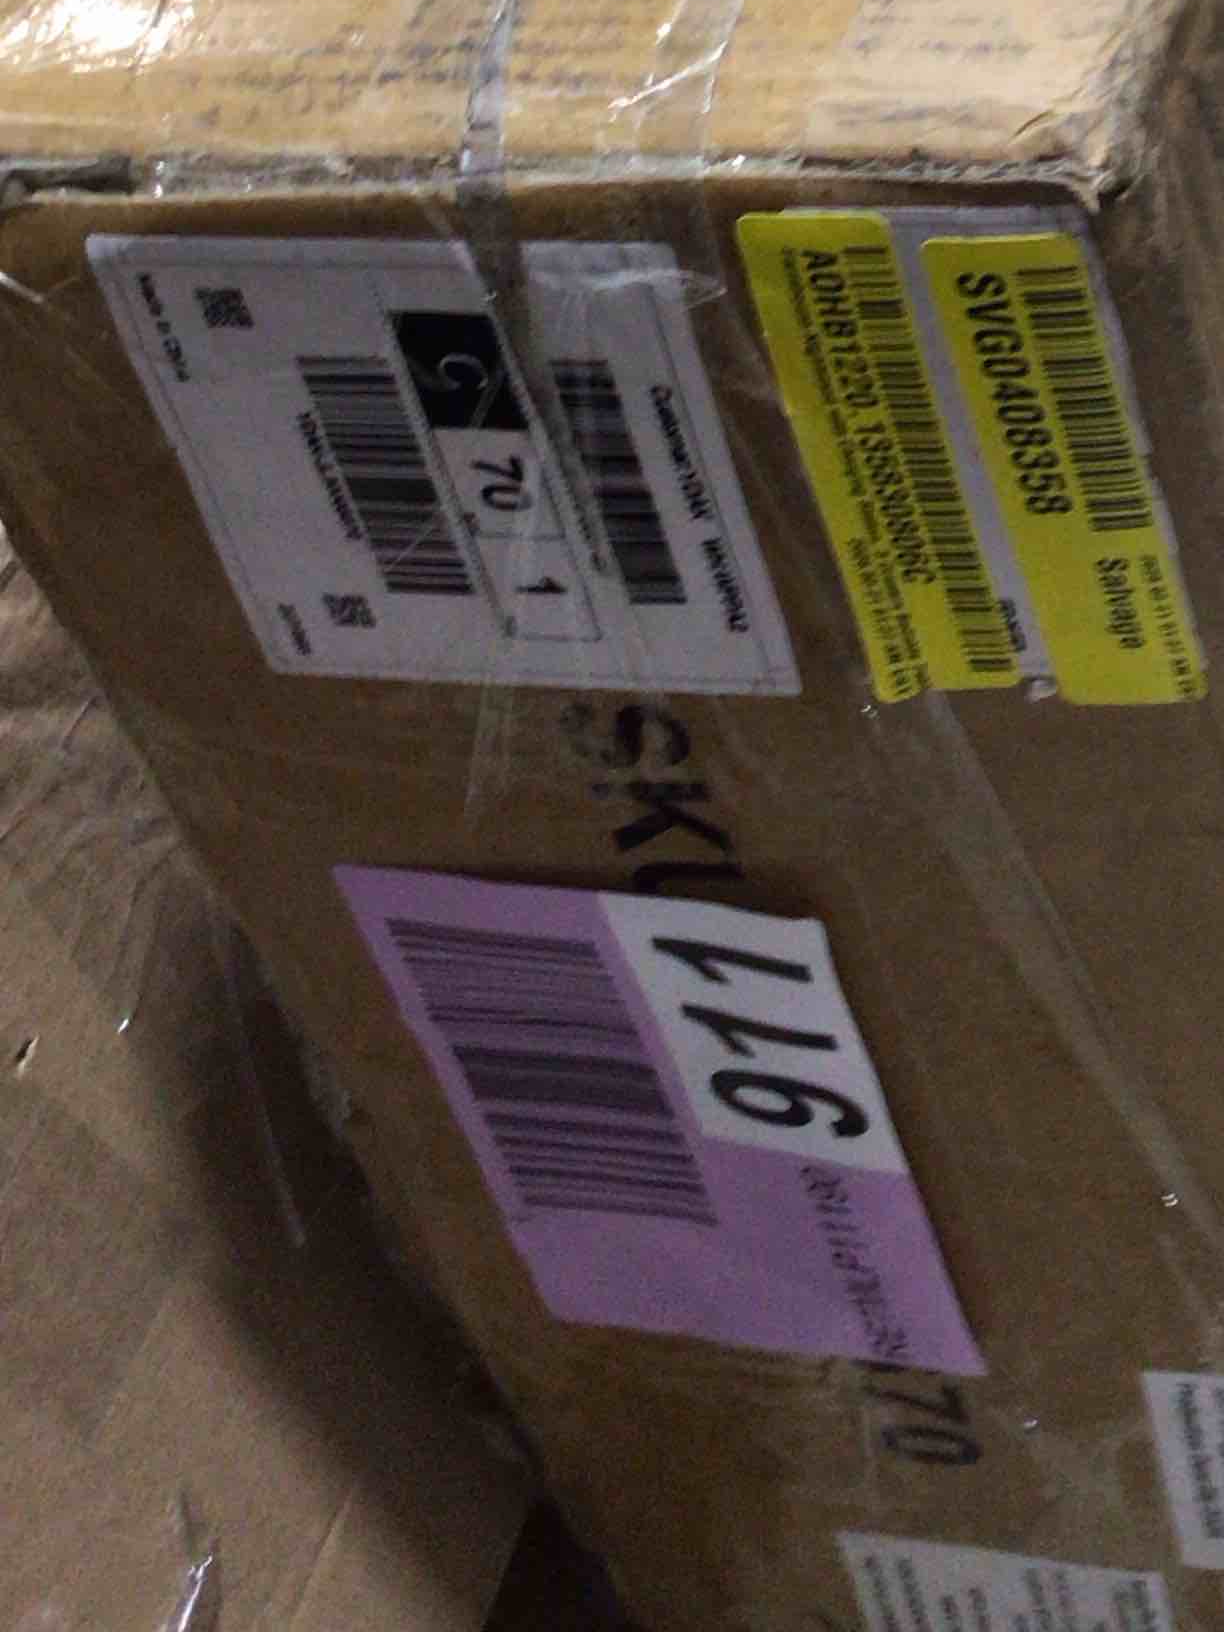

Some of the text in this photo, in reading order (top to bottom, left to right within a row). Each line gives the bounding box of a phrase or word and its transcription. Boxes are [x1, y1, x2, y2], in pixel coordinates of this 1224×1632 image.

[957, 271, 1074, 517] SVG0408358
[473, 454, 533, 513] 70
[1094, 557, 1147, 649] Salvage
